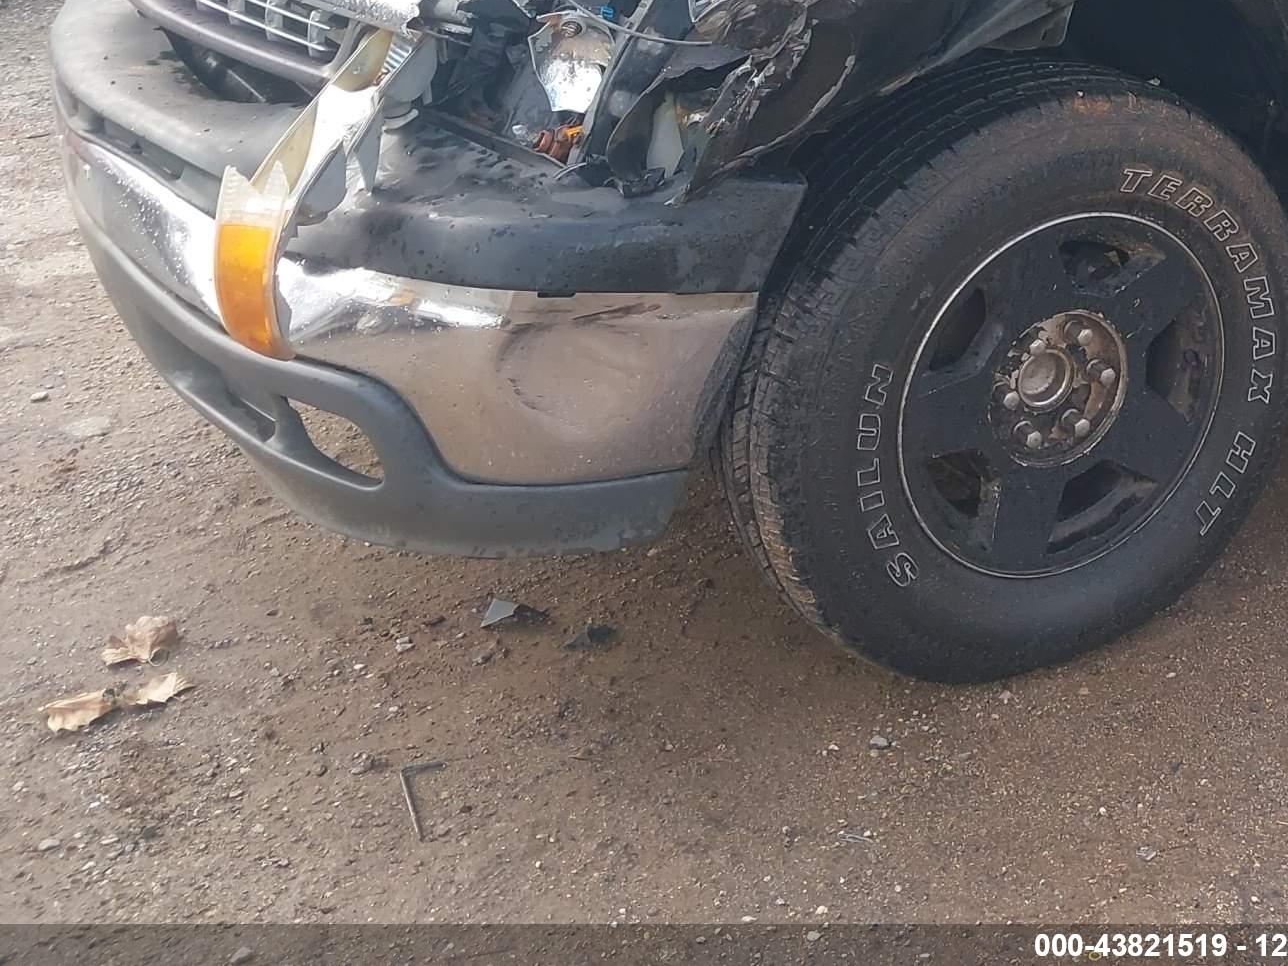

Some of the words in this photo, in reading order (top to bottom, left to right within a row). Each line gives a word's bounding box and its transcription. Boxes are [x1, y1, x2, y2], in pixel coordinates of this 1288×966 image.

[1119, 168, 1276, 404] TERRAMAX
[857, 364, 919, 586] SAILUN
[1196, 431, 1257, 535] HLT
